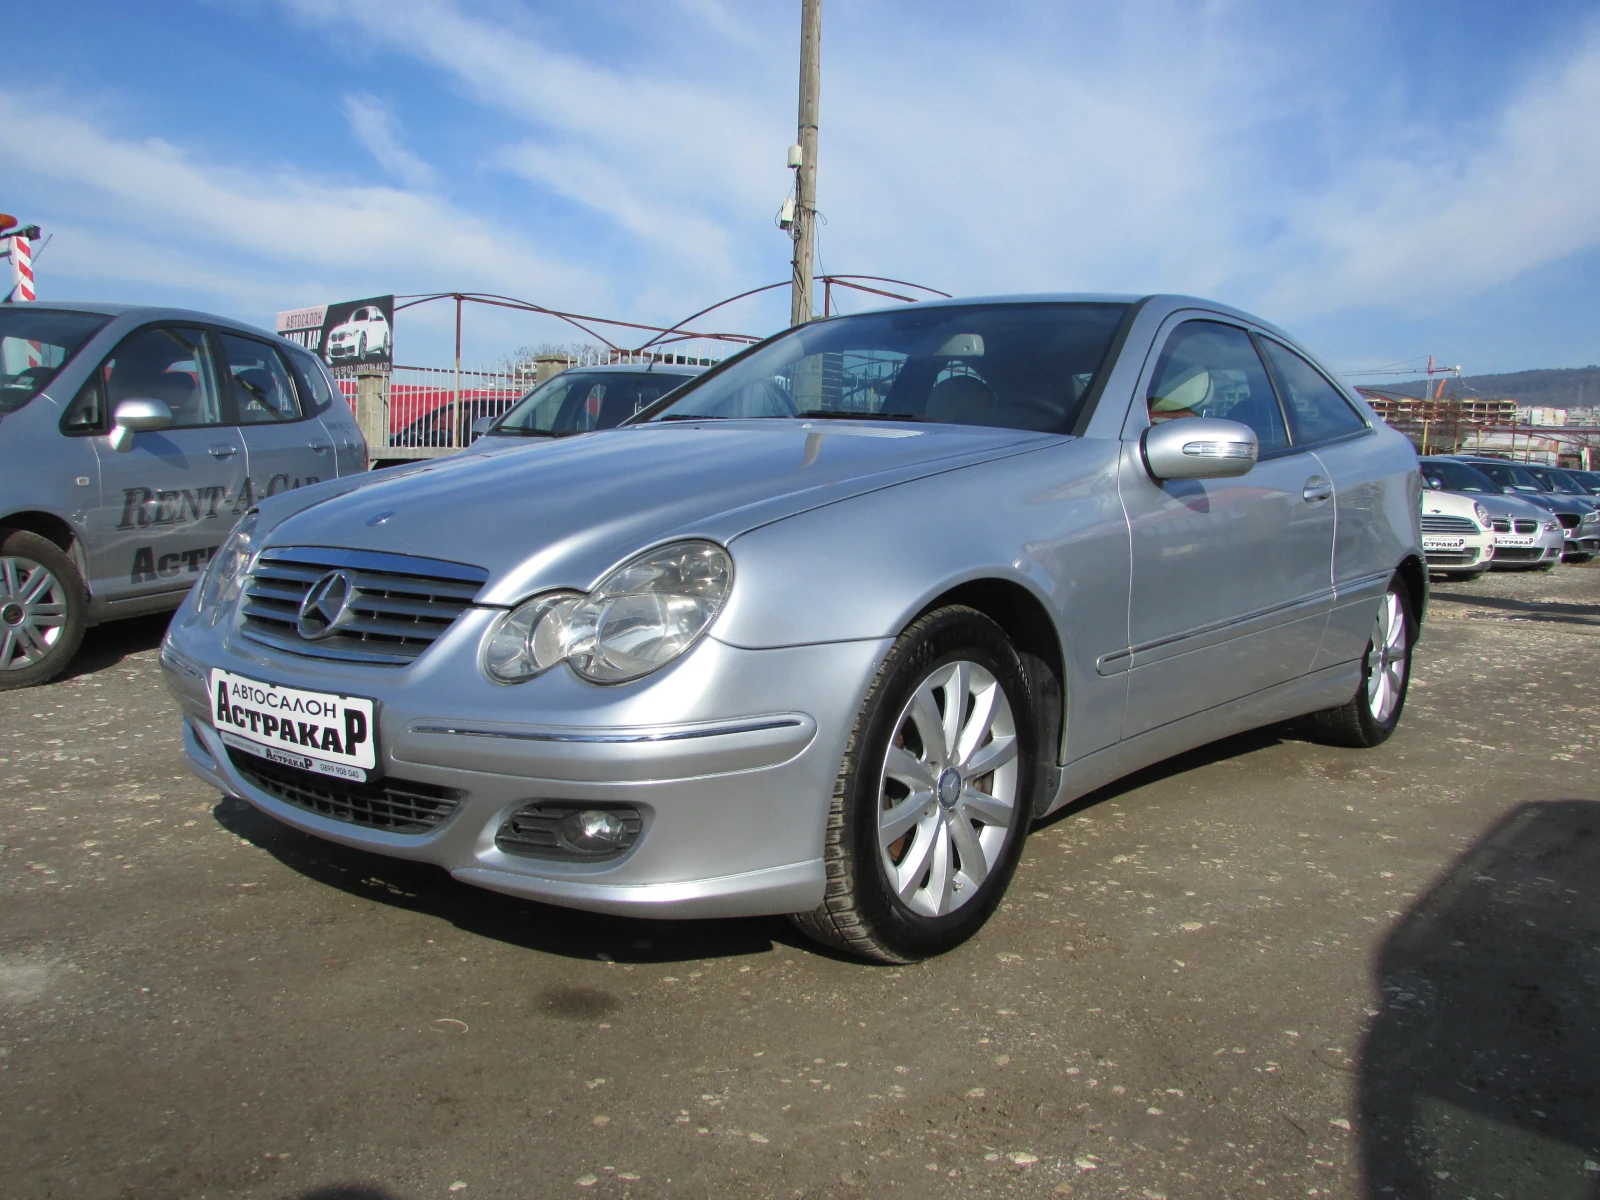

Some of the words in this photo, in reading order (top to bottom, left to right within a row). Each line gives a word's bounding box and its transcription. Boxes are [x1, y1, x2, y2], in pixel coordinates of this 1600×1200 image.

[286, 312, 323, 329] АВТОСАЛОН
[308, 330, 321, 349] КАР
[232, 683, 336, 718] АВТОСАЛОН
[217, 680, 367, 756] АСТРАКАР
[266, 748, 313, 769] АСТРАКАР
